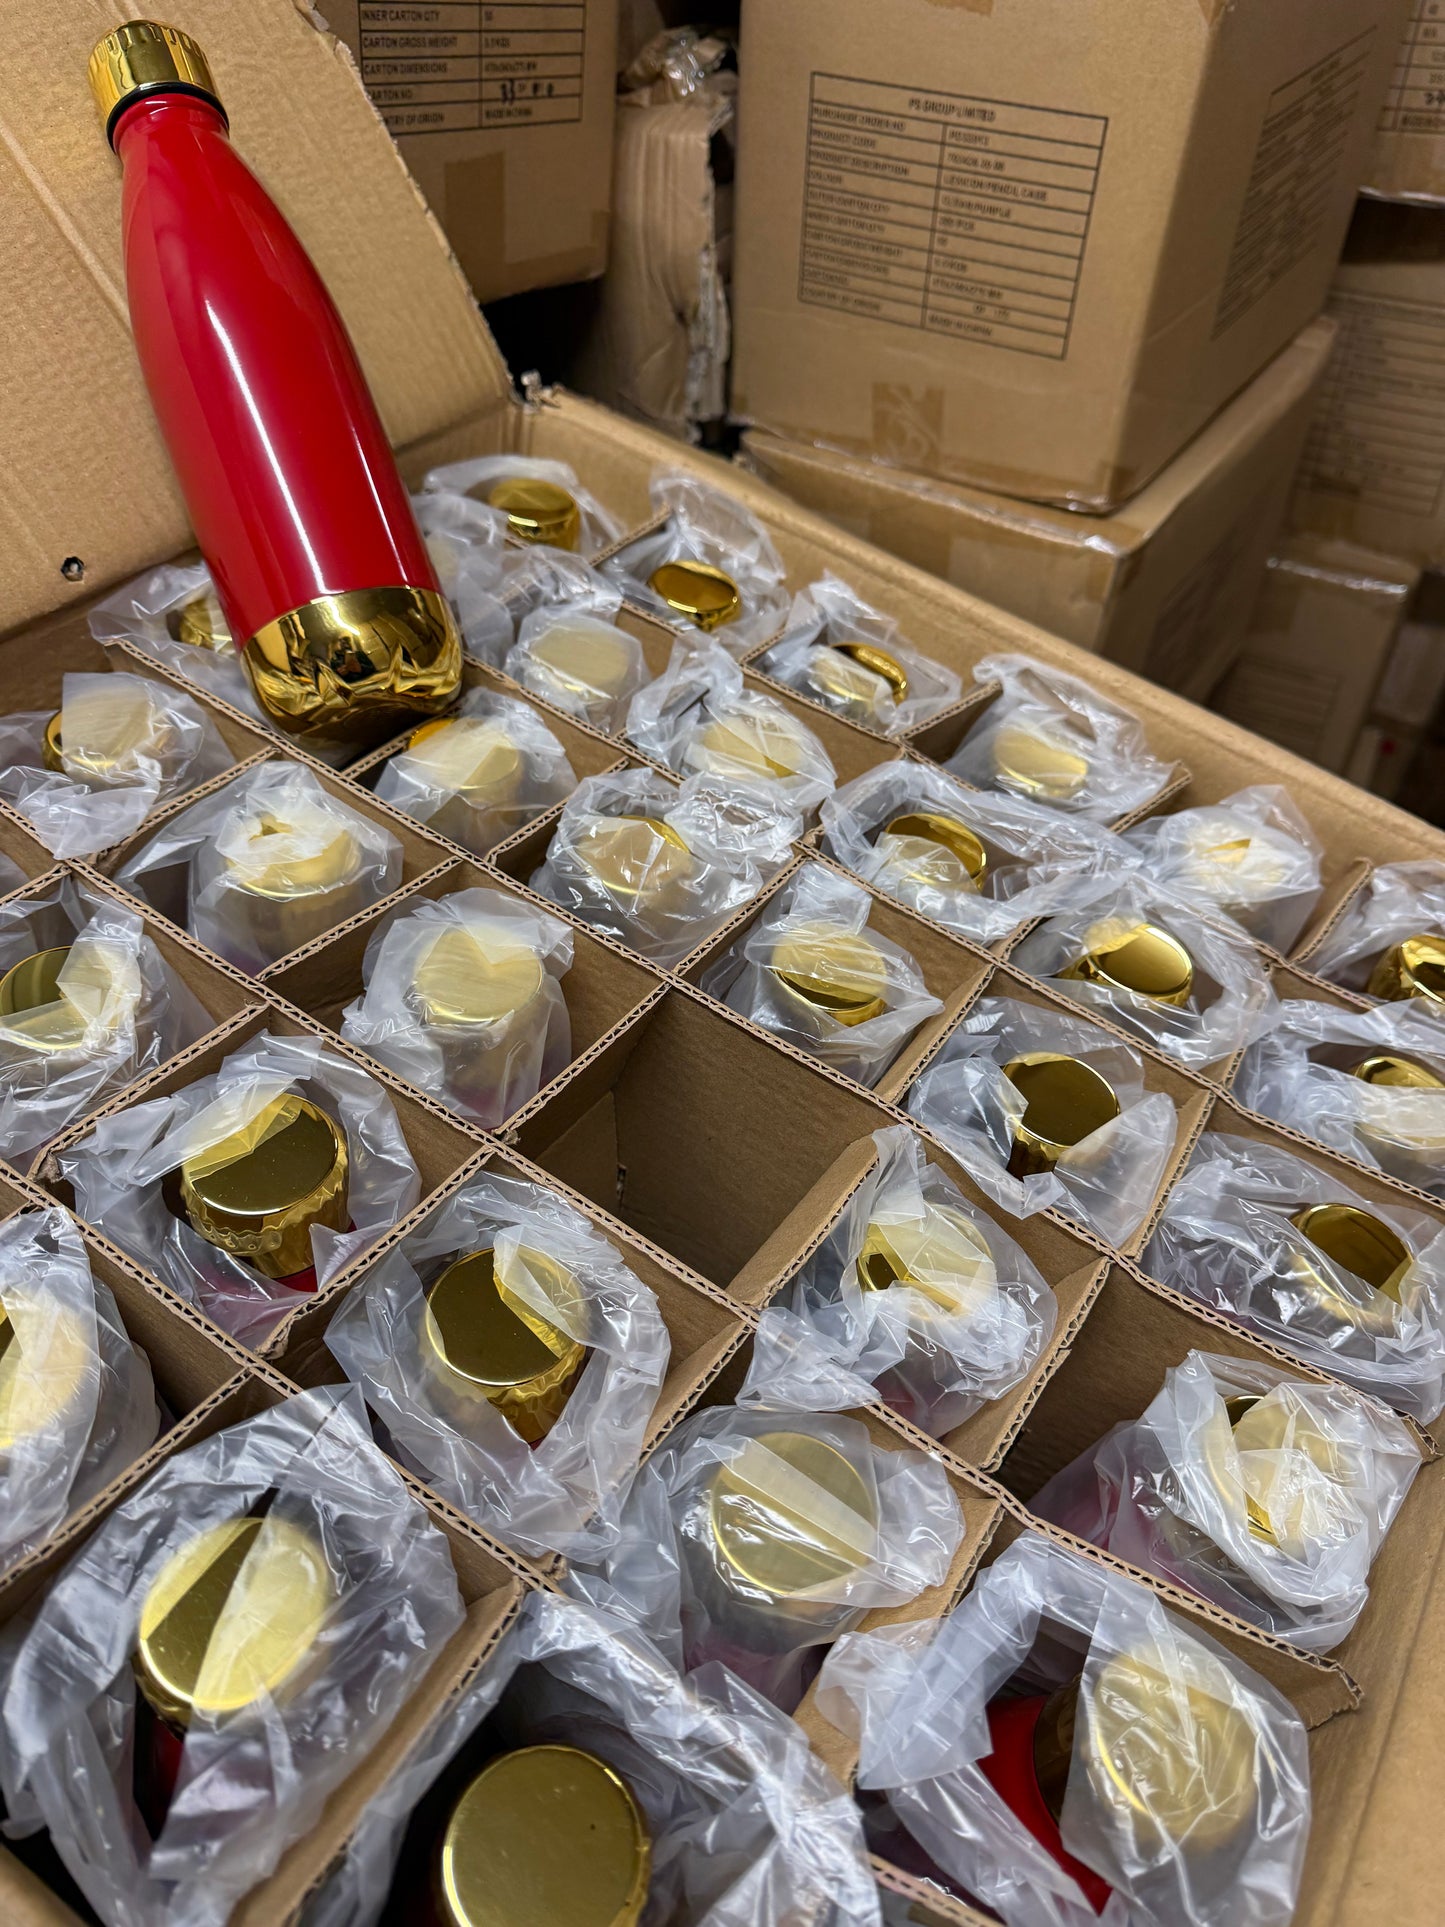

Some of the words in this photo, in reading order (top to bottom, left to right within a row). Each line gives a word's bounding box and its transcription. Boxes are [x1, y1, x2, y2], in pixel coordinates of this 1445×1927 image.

[388, 10, 422, 21] CARTON
[363, 37, 398, 48] CARTON
[399, 37, 427, 48] GROSS
[364, 64, 398, 75] CARTON
